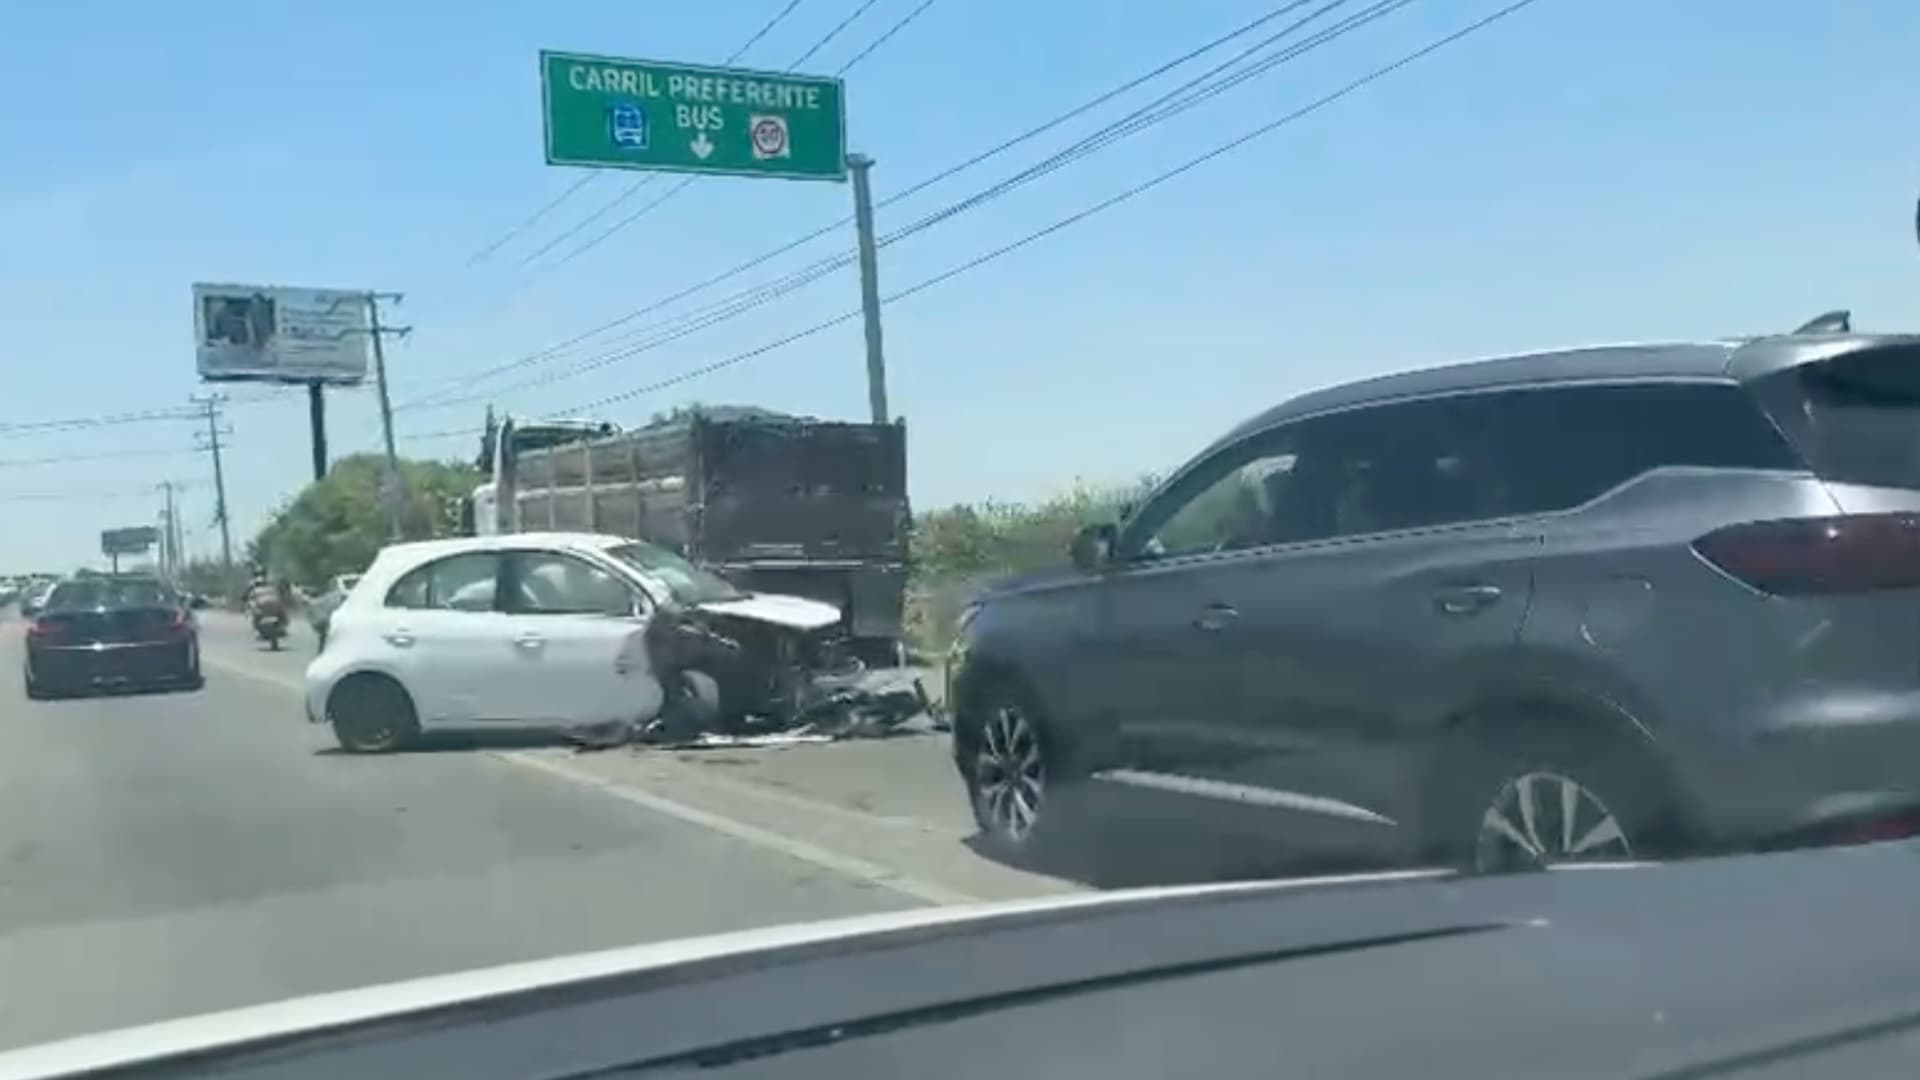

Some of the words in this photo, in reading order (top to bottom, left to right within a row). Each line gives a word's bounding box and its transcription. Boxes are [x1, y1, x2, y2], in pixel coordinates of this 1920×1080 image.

[569, 66, 660, 96] CARRIL
[668, 75, 821, 109] PREFERENTE
[675, 104, 724, 130] BUS
